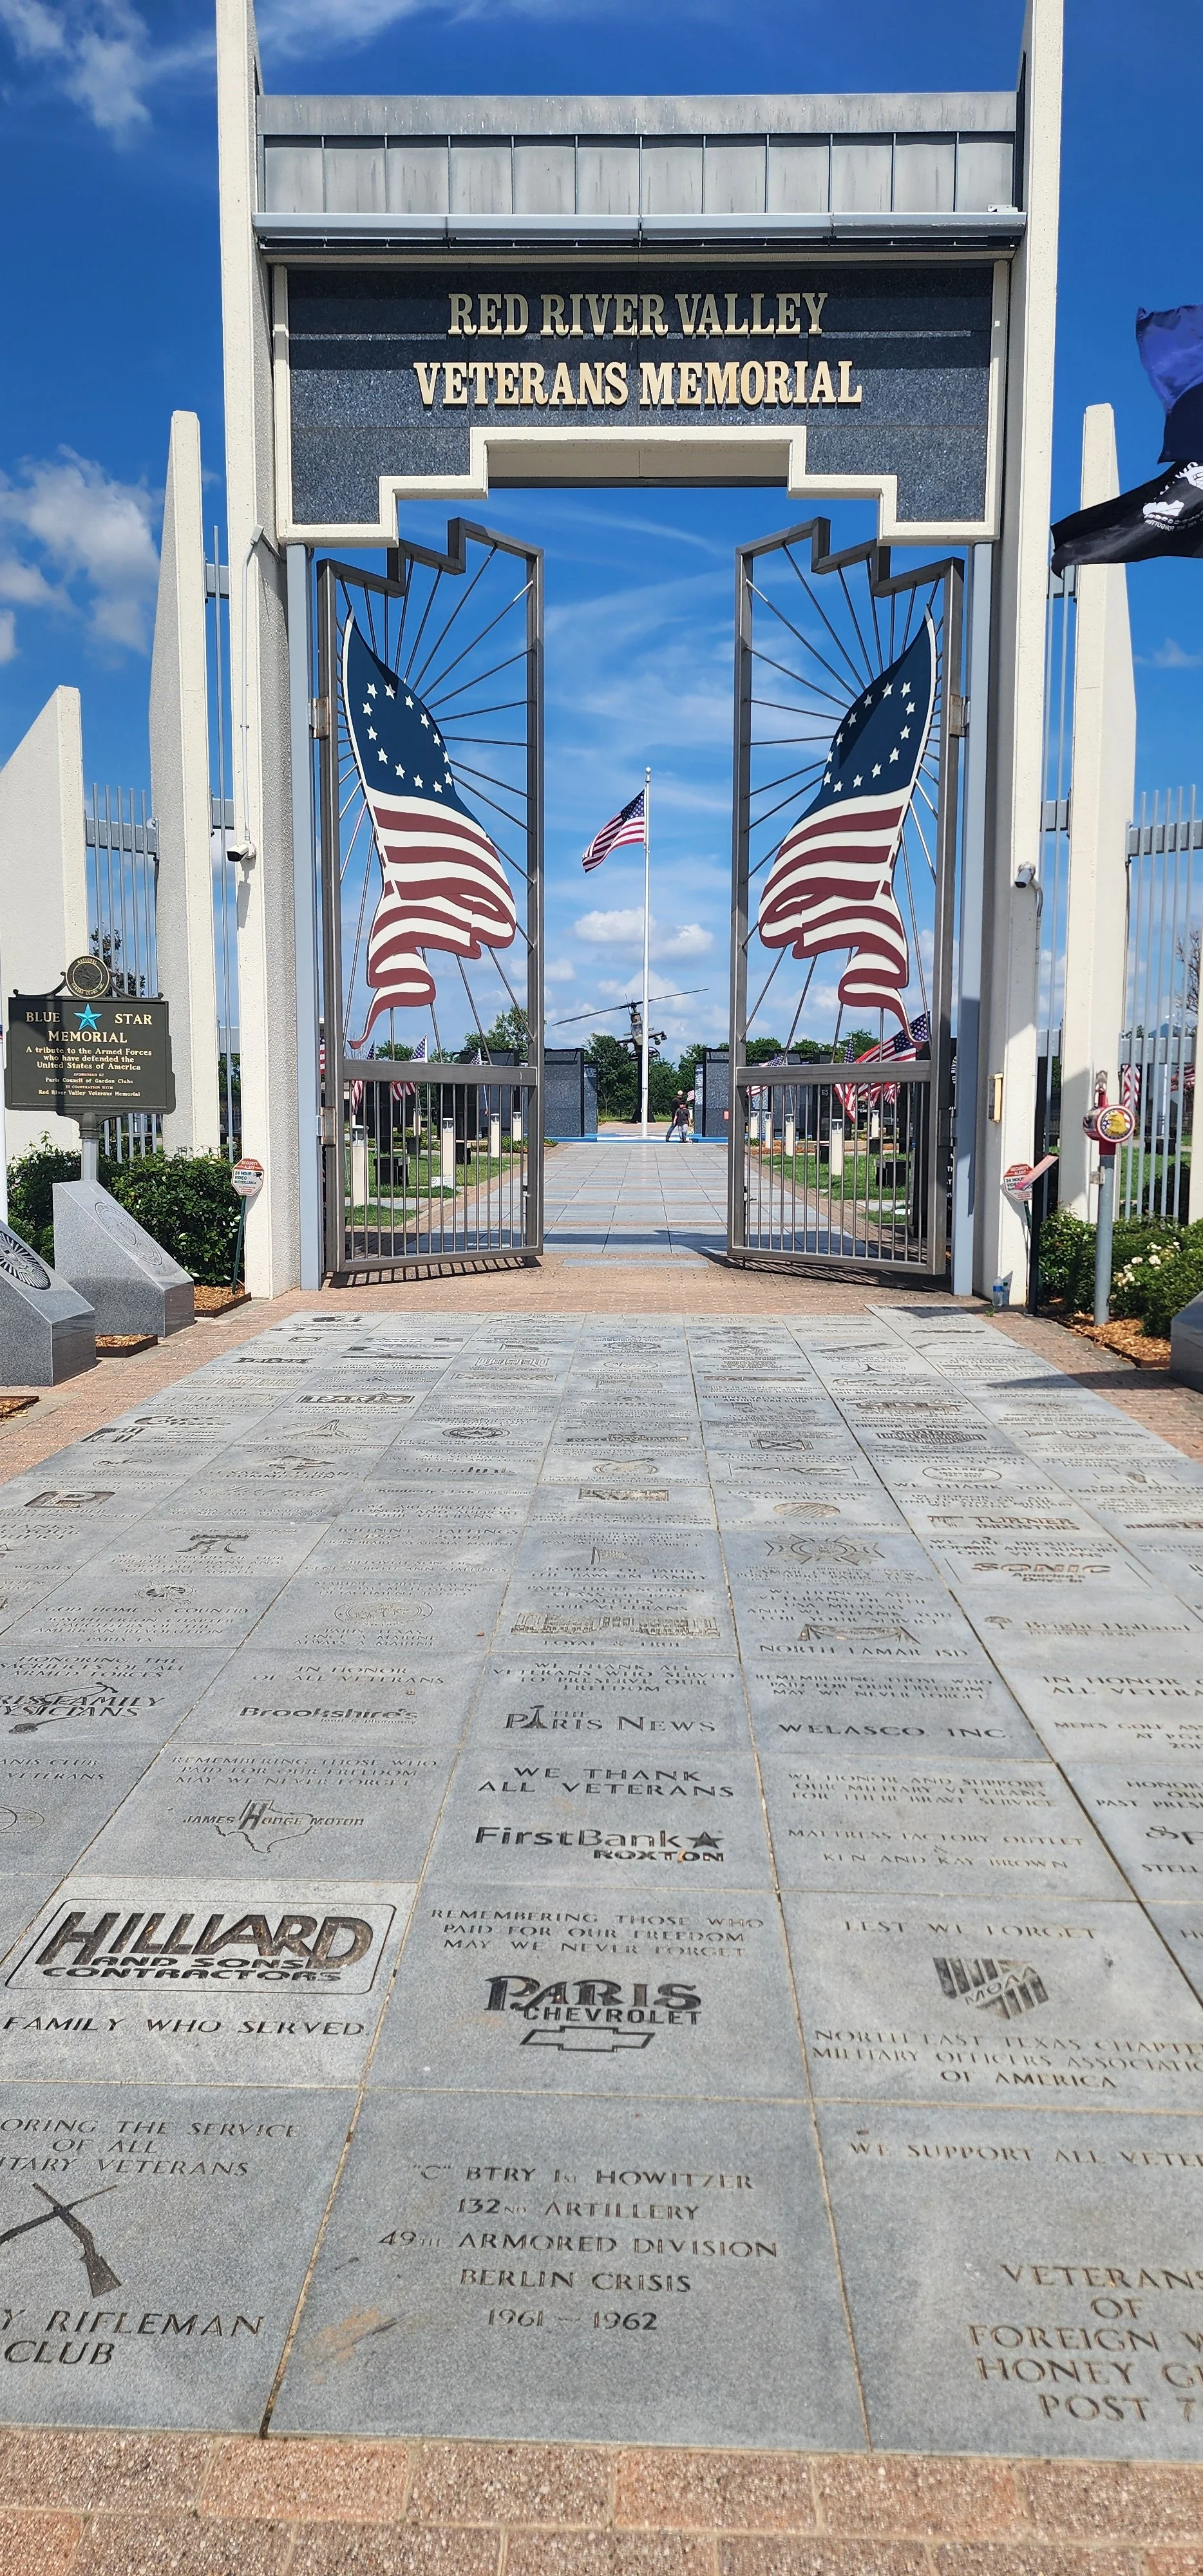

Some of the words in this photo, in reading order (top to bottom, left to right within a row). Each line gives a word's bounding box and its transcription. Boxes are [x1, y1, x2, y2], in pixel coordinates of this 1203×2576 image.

[448, 293, 529, 336] RED
[540, 294, 668, 336] RIVER
[675, 292, 828, 335] VALLEY
[413, 361, 629, 406] VETERANS
[639, 361, 862, 406] MEMORIAL
[26, 1012, 61, 1023] BLUE
[115, 1013, 153, 1025] STAR
[48, 1030, 128, 1043] MEMORIAL
[126, 1048, 152, 1056] Forces
[969, 1516, 1076, 1525] TURNER
[971, 1562, 1112, 1573] SONIC
[1085, 1676, 1182, 1685] HONOR
[1052, 1686, 1096, 1695] ALL
[239, 1707, 419, 1720] Brookshire's
[617, 1715, 716, 1733] NEWS
[777, 1723, 925, 1738] WELASCO
[513, 1766, 561, 1779] WE
[583, 1768, 701, 1782] THANK
[477, 1781, 537, 1793] ALL
[562, 1783, 734, 1797] VETERANS
[182, 1815, 236, 1824] JAMES
[309, 1816, 365, 1826] MOTOR
[475, 1826, 683, 1849] FirstBank
[592, 1849, 725, 1862] ROXTON
[431, 1909, 599, 1924] REMEMBERING
[615, 1913, 688, 1927] THOSE
[708, 1917, 764, 1929] WHO
[844, 1920, 909, 1933] LEST
[34, 1911, 374, 1969] HILLIARD
[443, 1924, 493, 1935] PAID
[508, 1925, 552, 1936] FOR
[567, 1927, 616, 1939] OUR
[443, 1939, 492, 1950] MAY
[510, 1940, 543, 1951] WE
[90, 1956, 178, 1967] AND
[191, 1957, 304, 1969] SONS
[42, 1966, 341, 1982] CONTRACTORS
[484, 1975, 702, 2011] PARIS
[2, 2016, 126, 2031] FAMILY
[147, 2019, 222, 2034] WHO
[524, 2007, 702, 2025] CHEVROLET
[813, 2028, 910, 2045] NORTH
[1002, 2035, 1082, 2051] TEXAS
[1094, 2040, 1203, 2055] CHAPTE
[995, 2072, 1118, 2089] AMERICA
[117, 2120, 173, 2135] THE
[191, 2122, 301, 2138] SERVICE
[52, 2138, 95, 2152] OF
[107, 2139, 158, 2154] ALL
[849, 2141, 892, 2157] WE
[907, 2143, 1034, 2163] SUPPORT
[1054, 2148, 1104, 2164] ALL
[98, 2158, 250, 2176] VETERANS
[466, 2166, 536, 2183] BTRY
[596, 2169, 754, 2190] HOWITZER
[544, 2201, 700, 2221] ARTILLERY
[458, 2231, 617, 2253] ARMORED
[633, 2237, 778, 2258] DIVISION
[459, 2268, 575, 2289] BERLIN
[591, 2272, 692, 2293] CRISIS
[1090, 2297, 1144, 2320] OF
[1, 2309, 26, 2330] Y
[44, 2310, 265, 2337] RIFLEMAN
[487, 2307, 545, 2328] 1961
[592, 2310, 658, 2331] 1962
[967, 2324, 1160, 2352] FOREIGN
[4, 2340, 116, 2365] CLUB
[976, 2356, 1135, 2386] HONEY
[1037, 2393, 1150, 2424] POST
